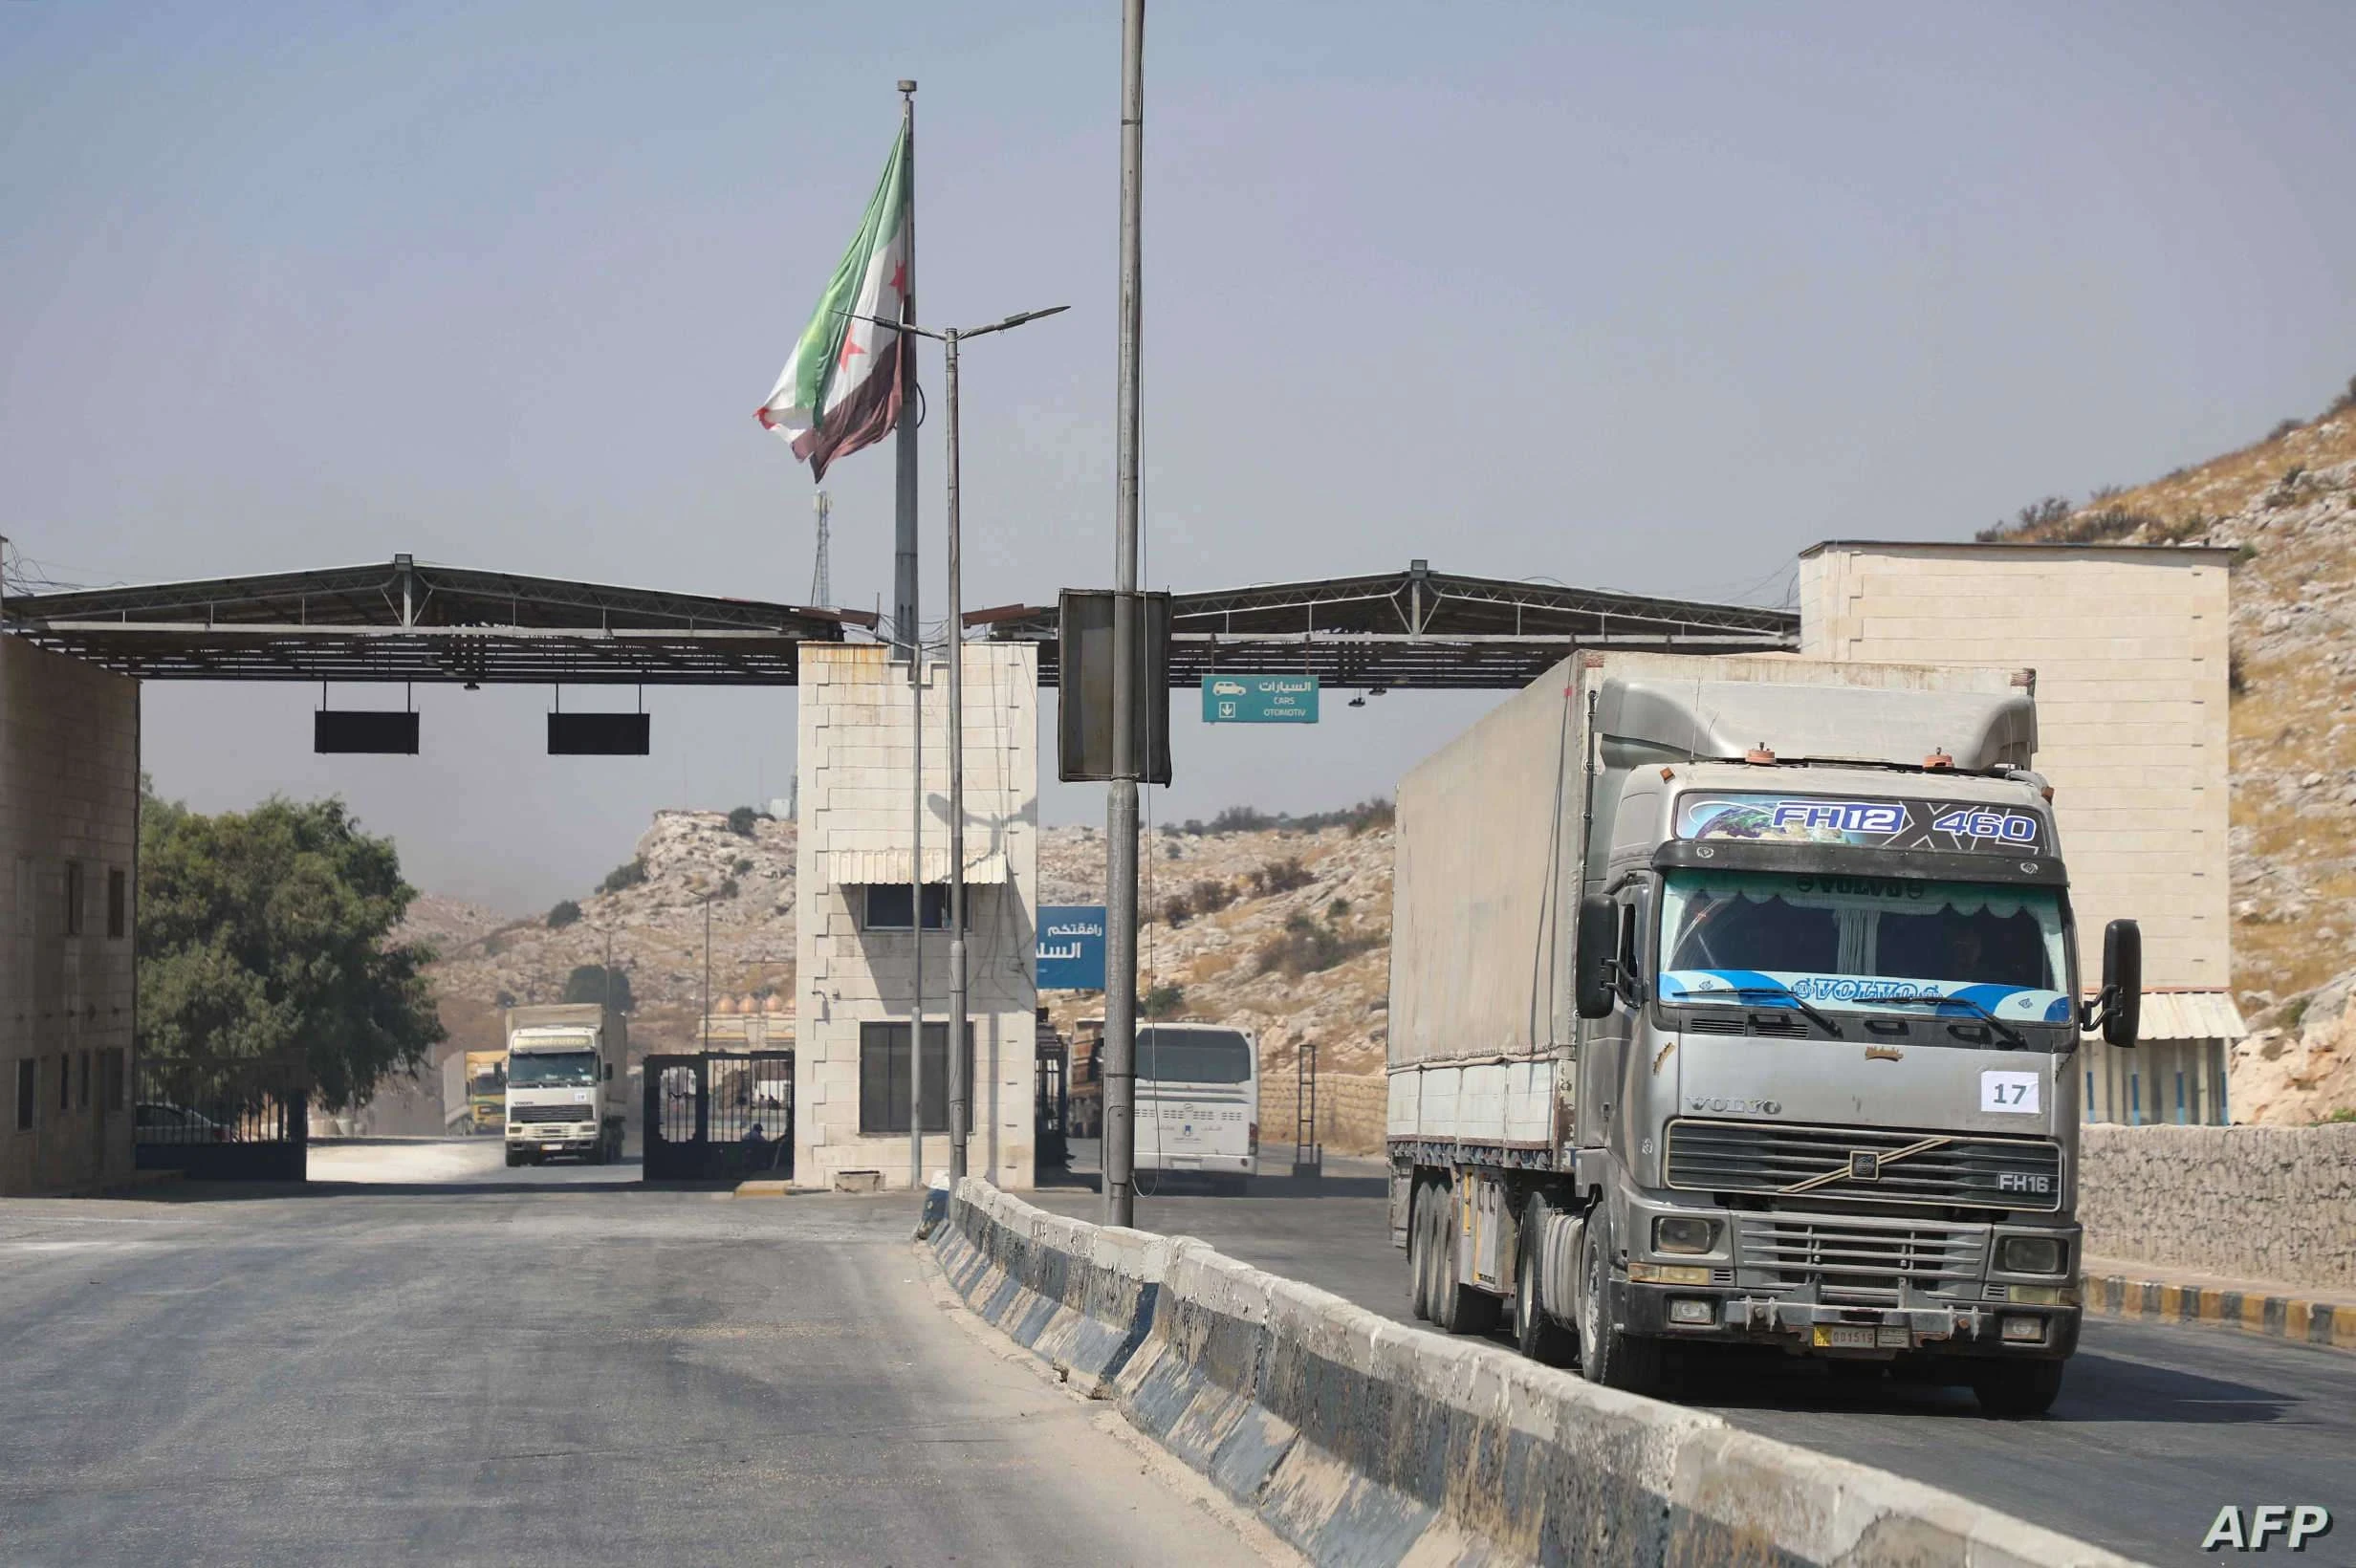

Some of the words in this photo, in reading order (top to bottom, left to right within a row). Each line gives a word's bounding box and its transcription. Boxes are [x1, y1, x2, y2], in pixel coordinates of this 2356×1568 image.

[1258, 681, 1311, 693] السيارات
[1263, 708, 1306, 717] OTOMOTIV
[1773, 804, 1905, 833] FH12
[1932, 811, 2037, 841] 460
[1815, 978, 1918, 1002] VOLVO
[1994, 1083, 2027, 1104] 17
[1683, 1097, 1782, 1114] VOLVO
[1999, 1174, 2049, 1192] FH16
